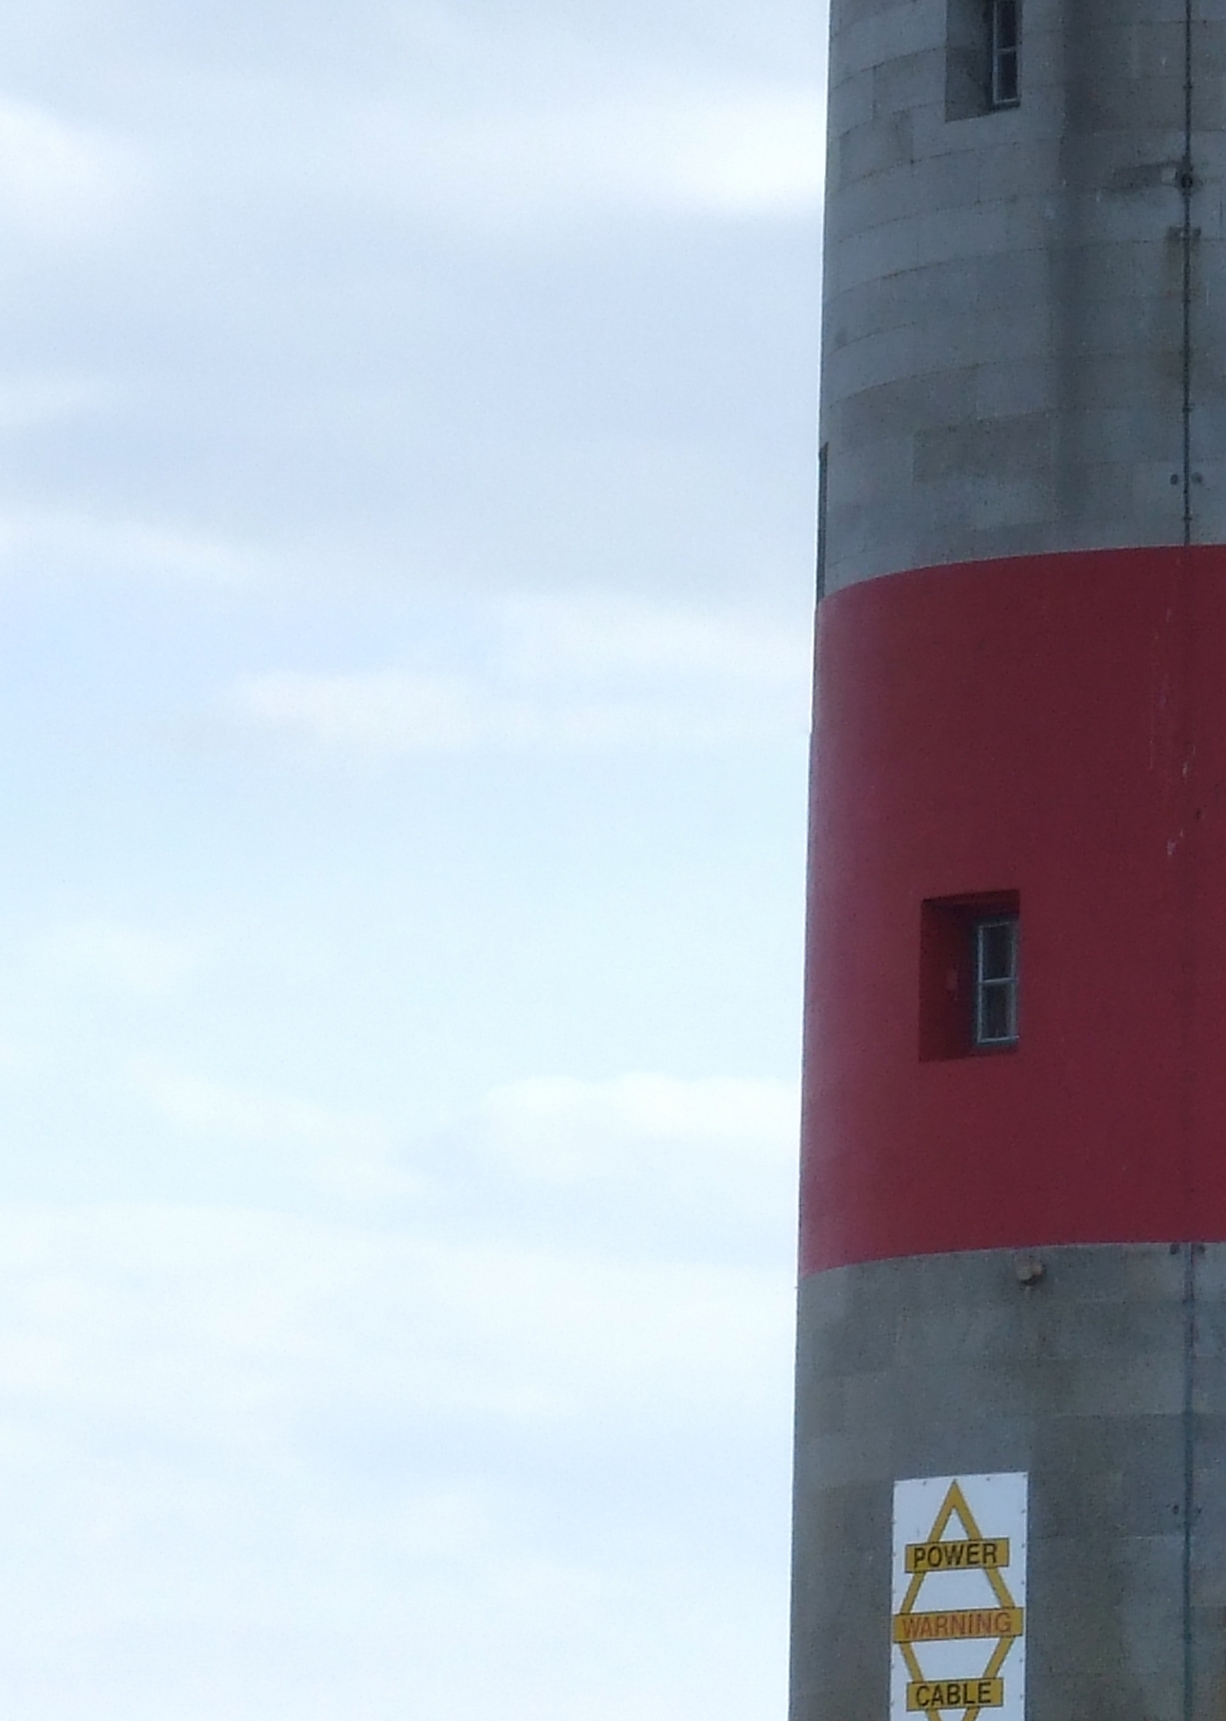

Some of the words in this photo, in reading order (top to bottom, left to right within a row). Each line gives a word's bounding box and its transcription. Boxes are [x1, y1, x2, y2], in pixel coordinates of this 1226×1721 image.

[913, 1543, 998, 1568] POWER
[902, 1612, 1012, 1639] WARNING
[916, 1682, 992, 1708] CABLE
